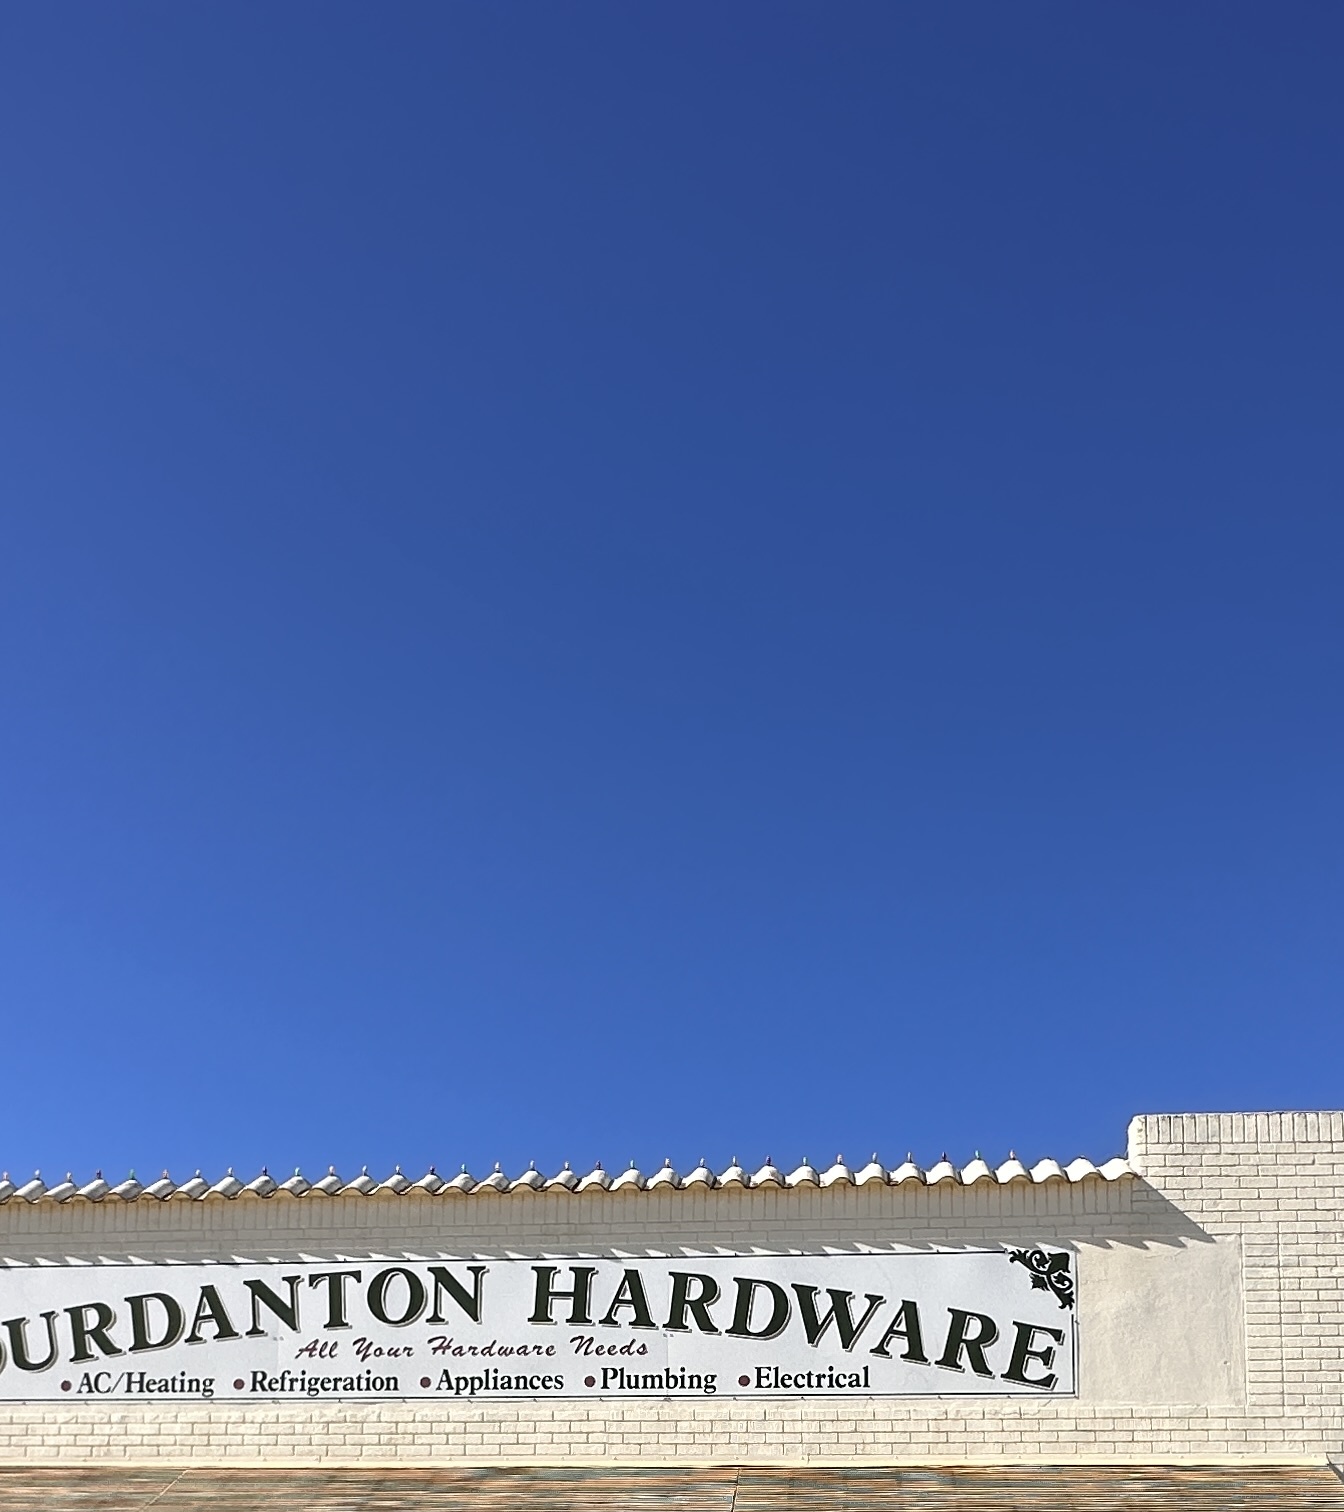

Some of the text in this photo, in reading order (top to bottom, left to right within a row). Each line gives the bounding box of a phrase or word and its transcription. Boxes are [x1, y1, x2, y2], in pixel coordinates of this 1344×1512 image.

[527, 1265, 1064, 1391] HARDWARE
[294, 1335, 649, 1361] All Your Hardware Needs
[75, 1366, 870, 1396] AC/Heating Refrigeration Appliances Plumbing Electrical
